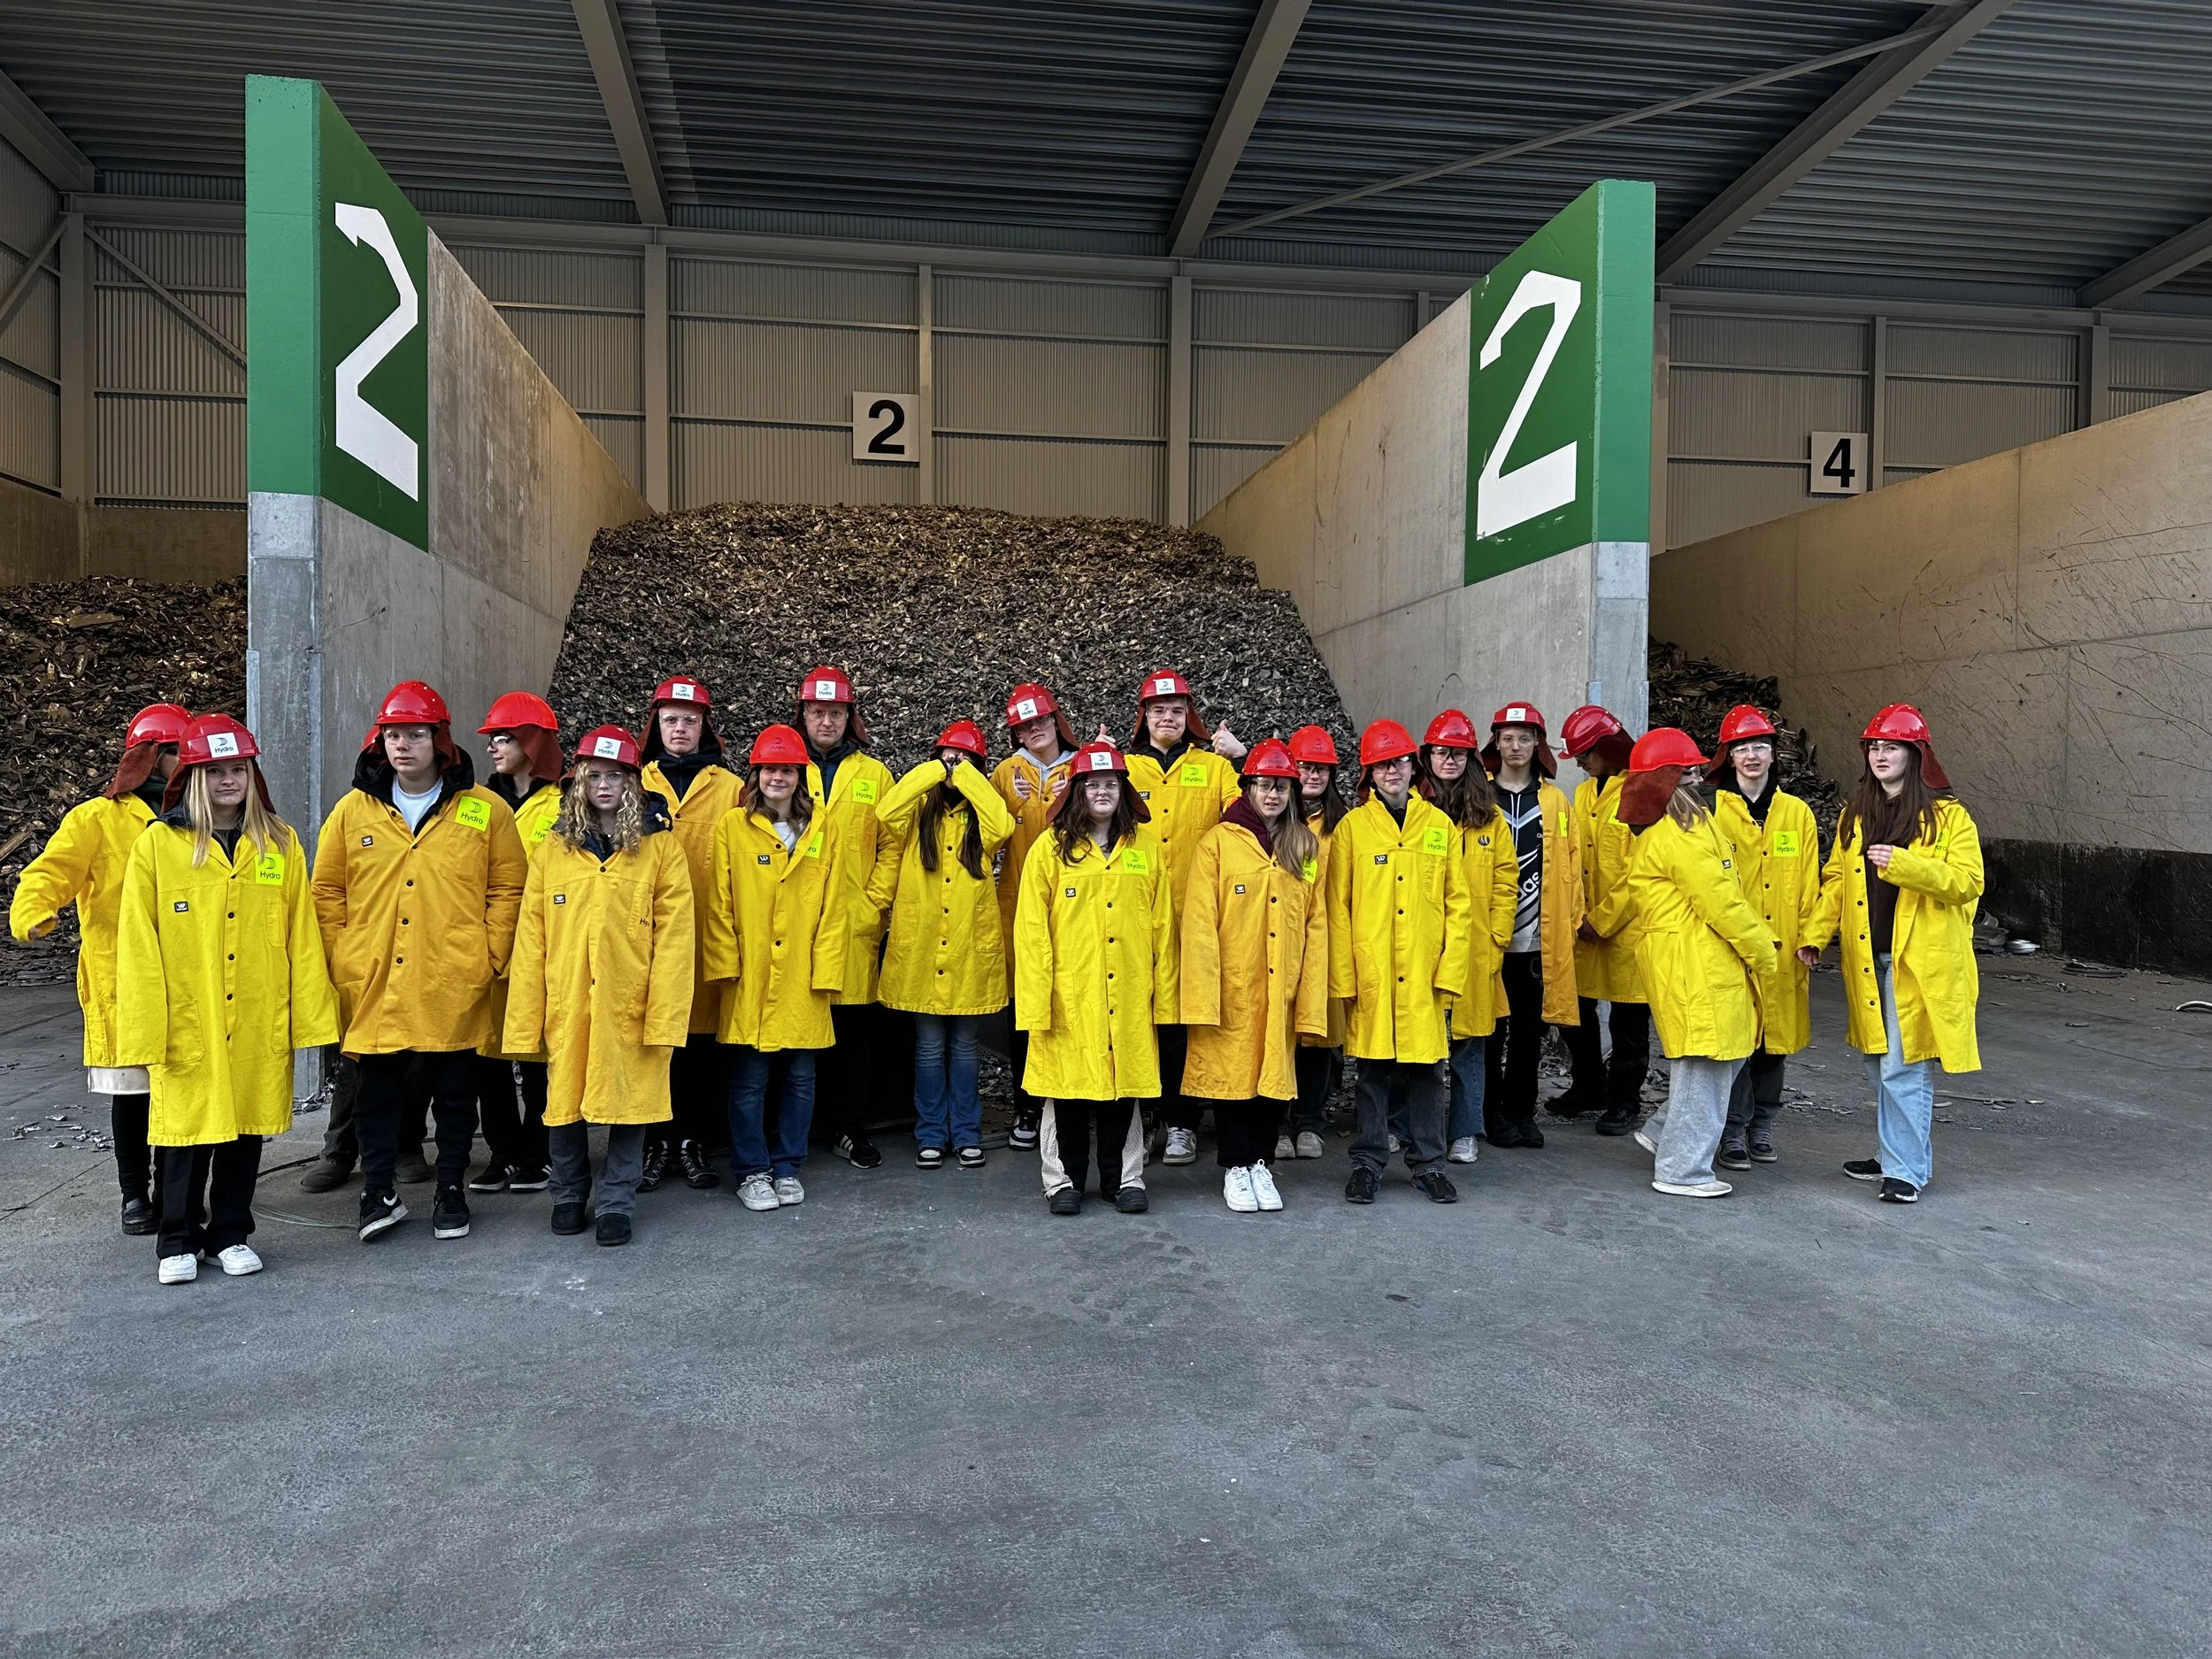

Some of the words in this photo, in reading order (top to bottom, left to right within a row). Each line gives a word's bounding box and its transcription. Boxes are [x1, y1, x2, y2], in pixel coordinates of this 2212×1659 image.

[334, 202, 419, 502] 2
[1477, 269, 1581, 541] 2
[868, 399, 906, 455] 2
[1823, 437, 1855, 488] 4
[856, 792, 872, 801] Hydro
[460, 811, 484, 825] Hydro
[260, 871, 280, 879] Hydro
[1126, 862, 1146, 871] Hydro
